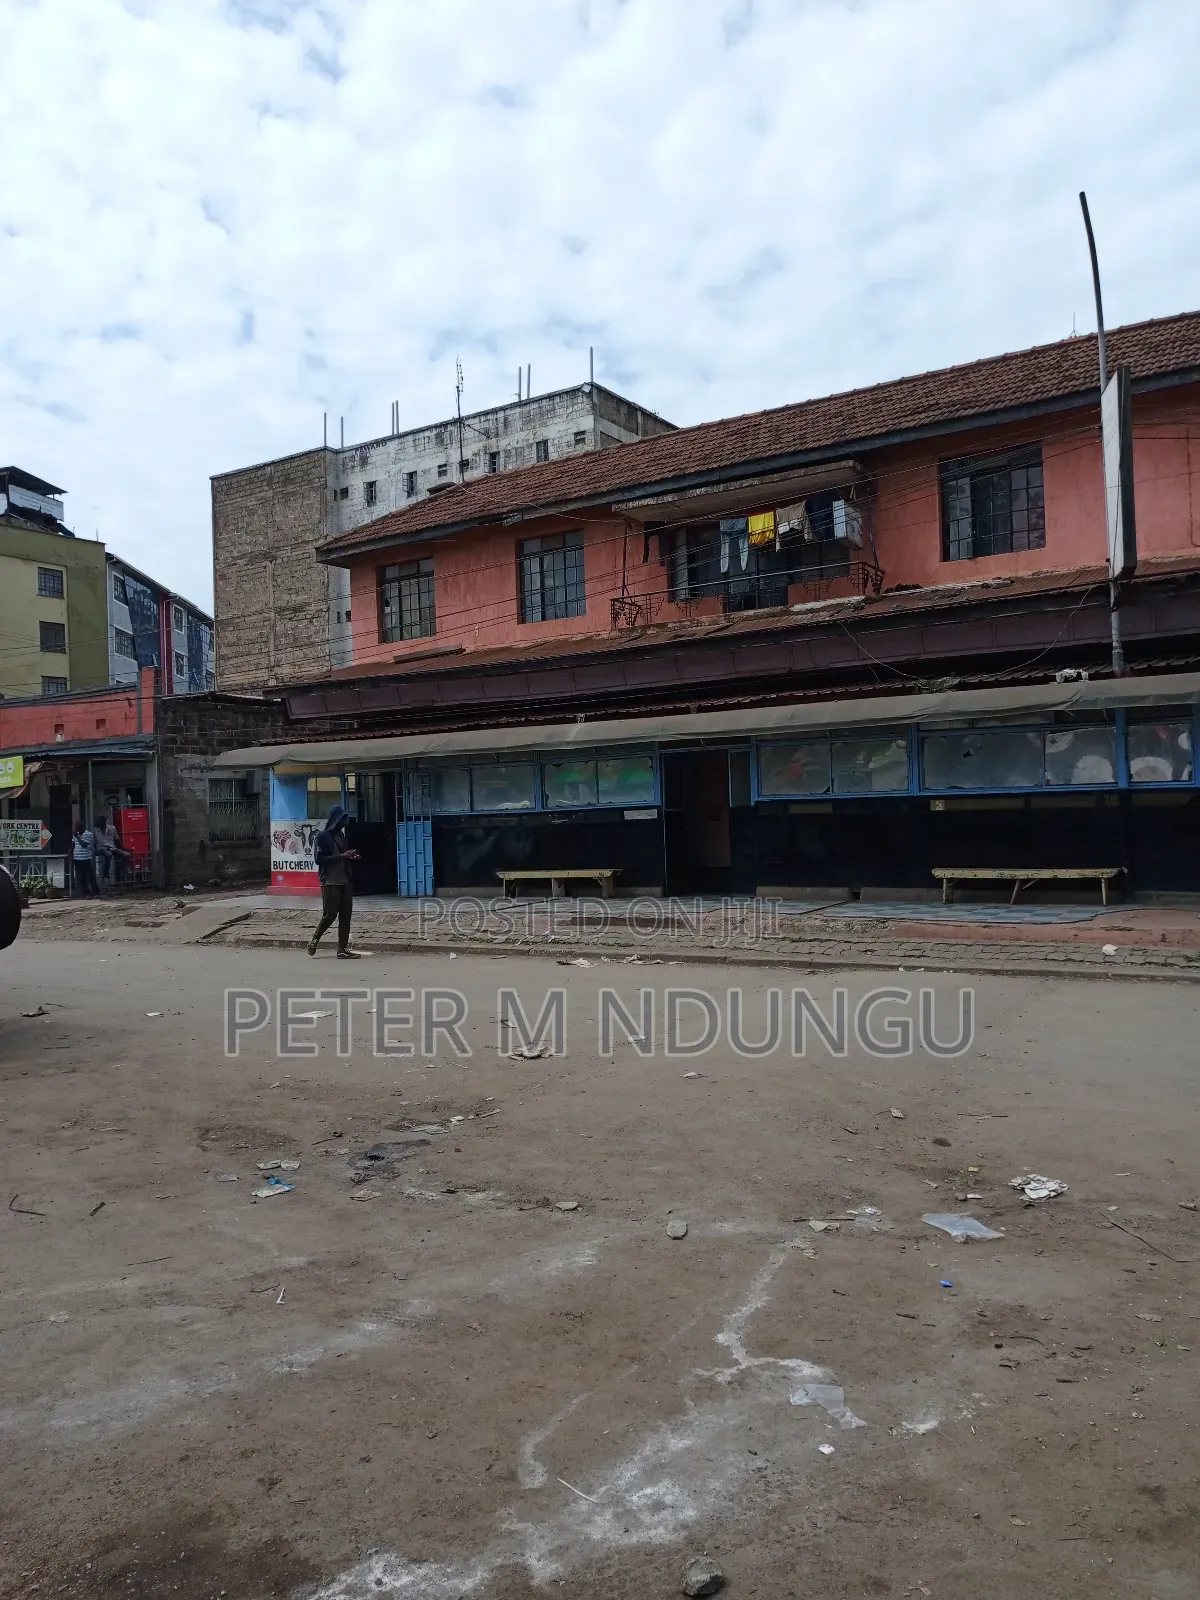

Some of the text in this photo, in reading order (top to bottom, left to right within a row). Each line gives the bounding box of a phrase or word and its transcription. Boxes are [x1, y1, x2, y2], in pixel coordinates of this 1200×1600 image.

[1, 822, 40, 830] ORK CENTRE
[272, 860, 315, 871] BUTCHERY
